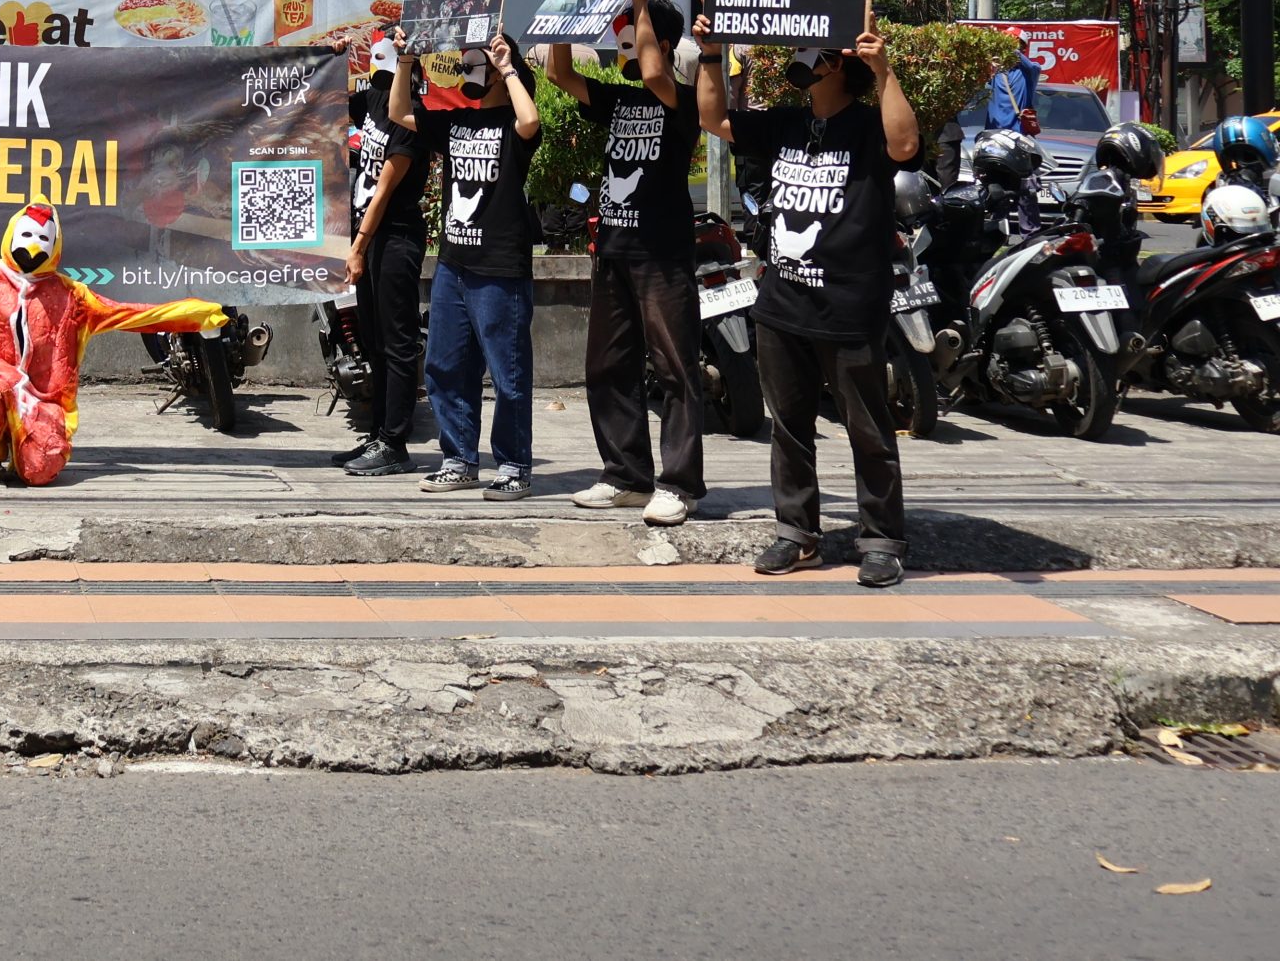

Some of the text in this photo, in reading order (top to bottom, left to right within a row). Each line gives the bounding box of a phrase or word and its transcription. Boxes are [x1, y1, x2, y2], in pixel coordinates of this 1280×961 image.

[282, 0, 305, 12] FRUIT
[282, 11, 305, 24] TEA
[526, 14, 612, 35] TERKURUNG
[713, 11, 830, 38] BEBAS SANGKAR
[1024, 29, 1065, 40] emat
[435, 53, 460, 64] PALING
[246, 65, 316, 79] ANIMAL
[241, 89, 308, 117] JOGJA
[249, 146, 308, 156] SCAN DI SINI
[122, 264, 329, 289] bit.ly/infocagefree
[913, 281, 935, 295] AVE
